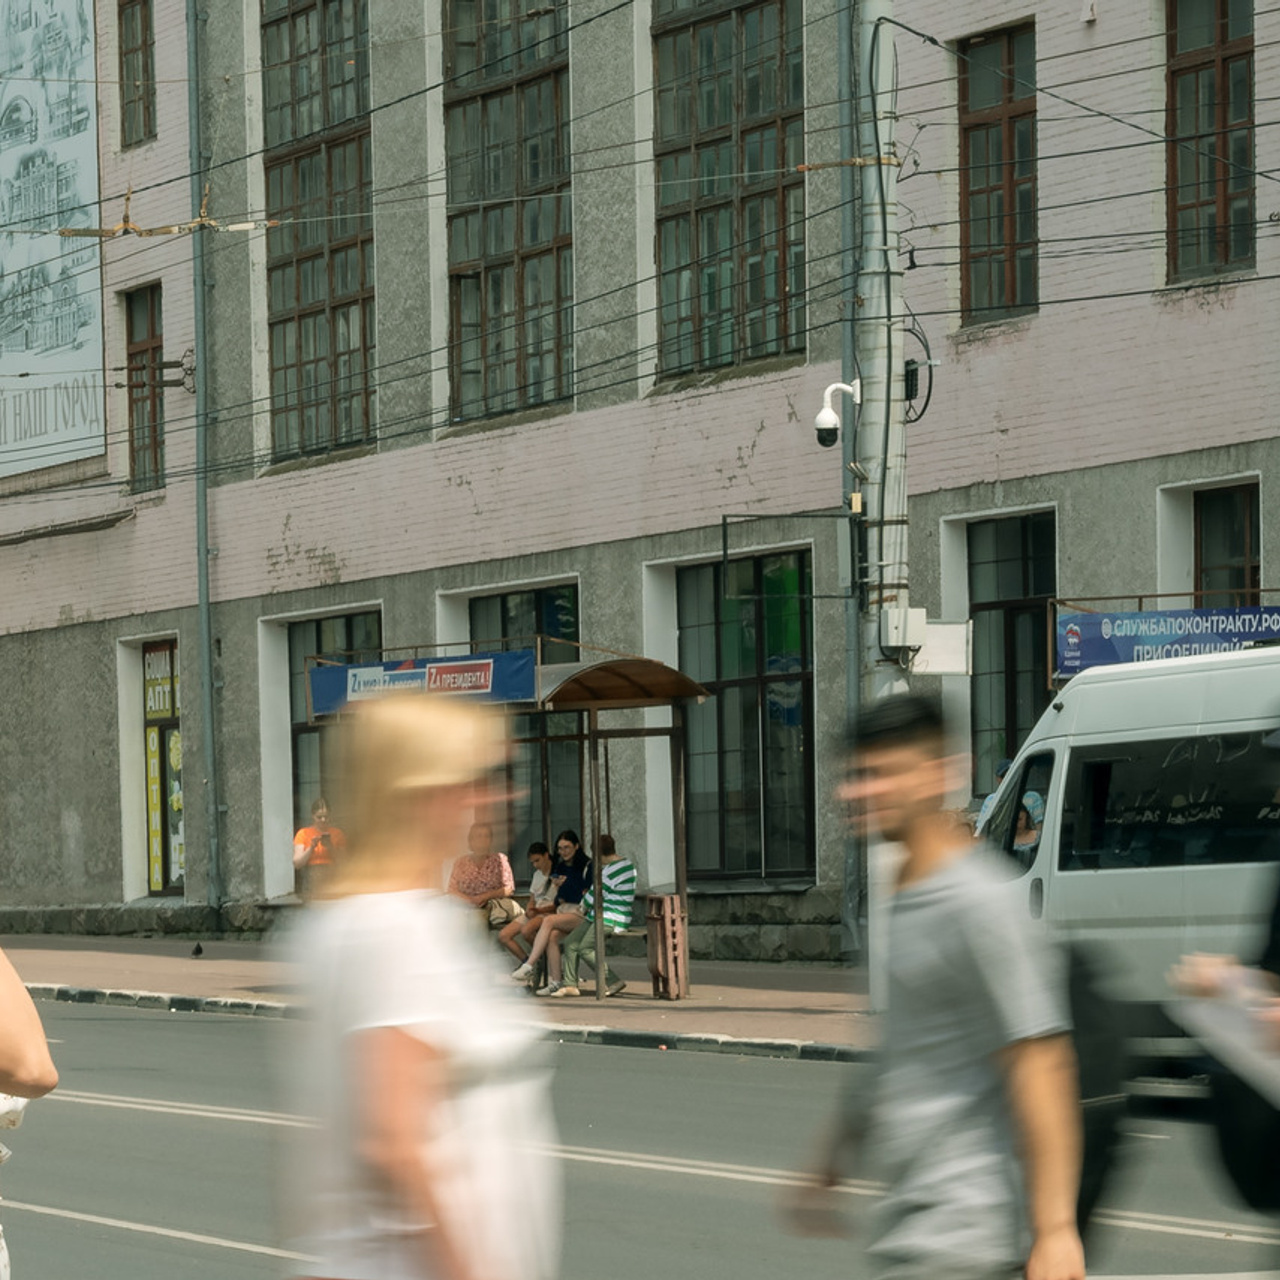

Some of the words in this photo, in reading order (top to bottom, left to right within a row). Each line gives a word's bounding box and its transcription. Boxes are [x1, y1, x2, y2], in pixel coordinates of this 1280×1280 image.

[13, 387, 48, 442] НАШ
[54, 373, 100, 433] ГОРОД
[1113, 613, 1280, 637] СЛУЖБАПОКОНТРАКТУ.РФ
[149, 731, 161, 883] ОПТИКА
